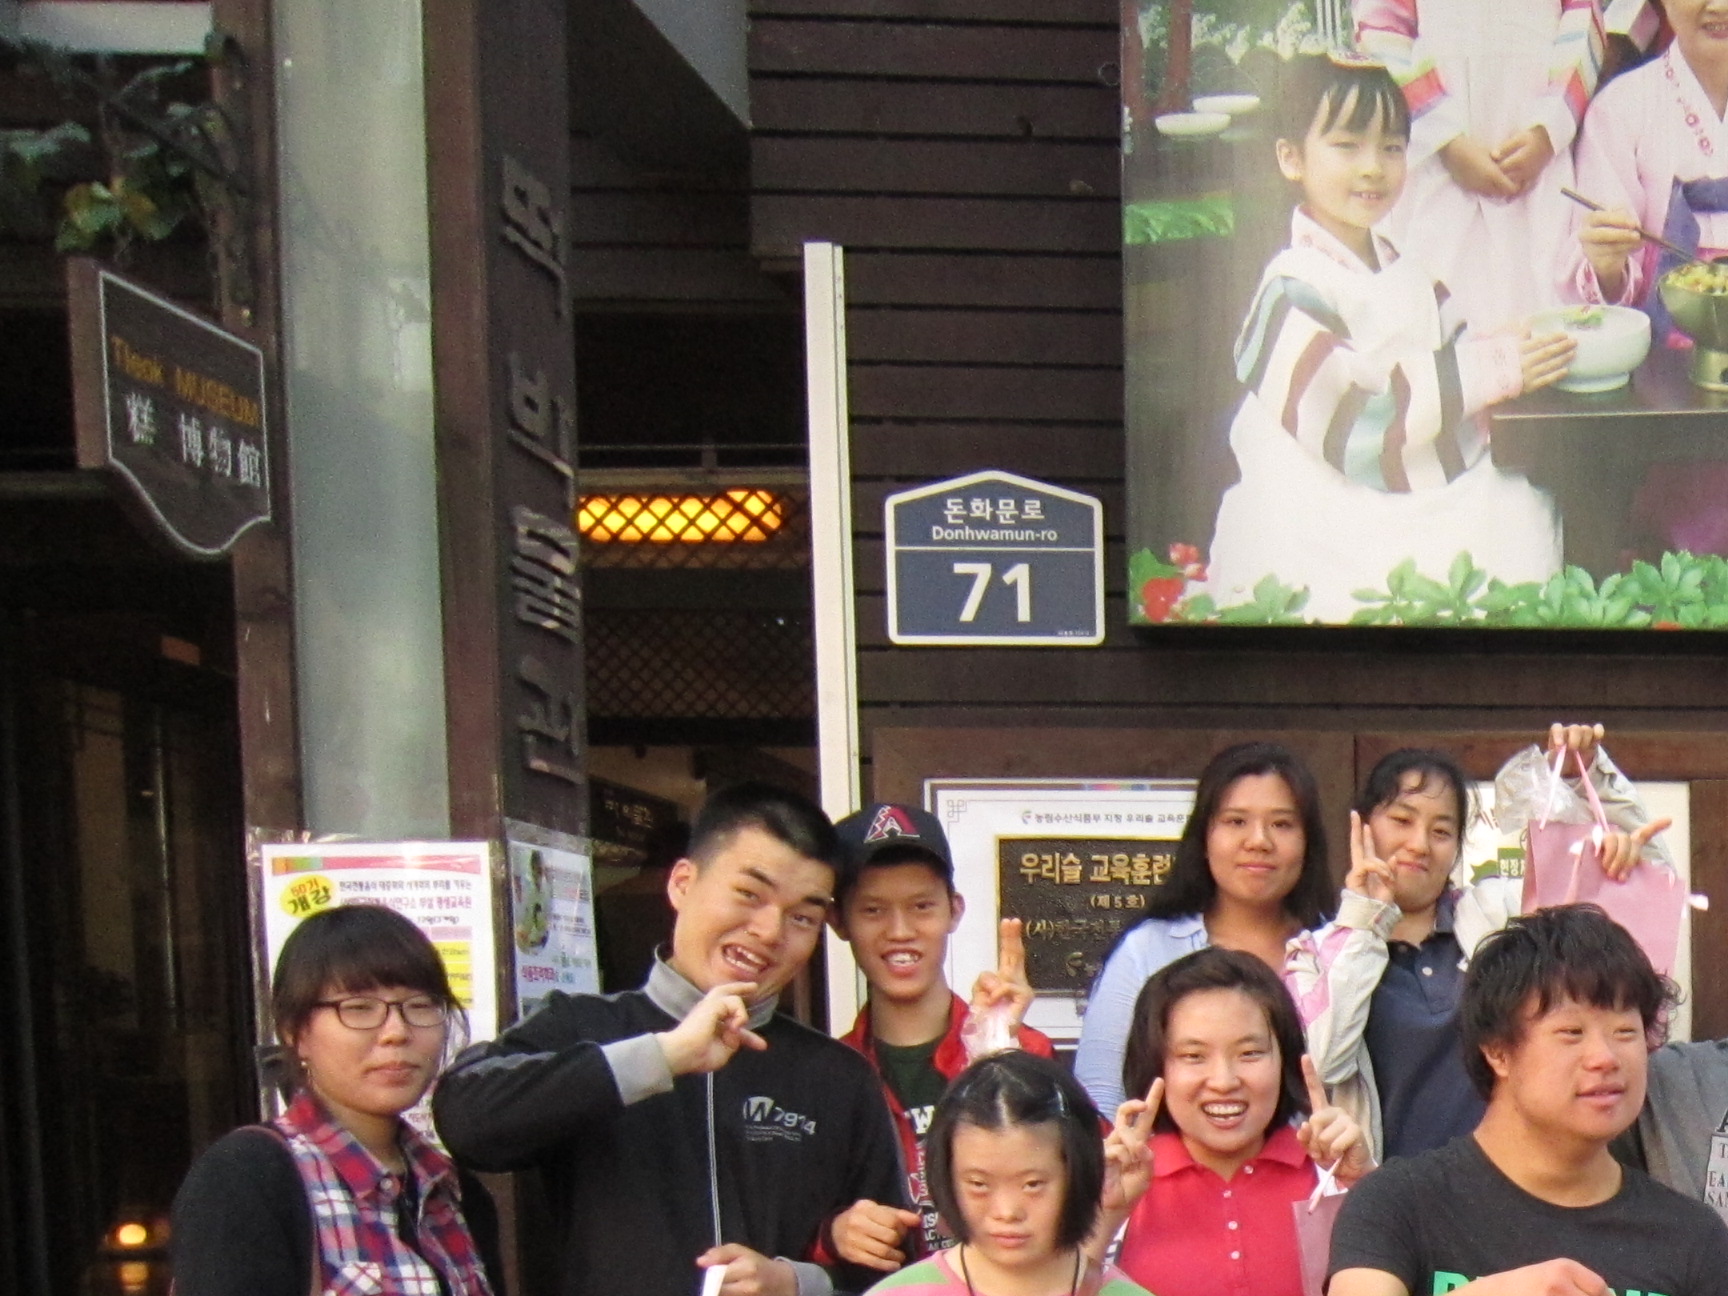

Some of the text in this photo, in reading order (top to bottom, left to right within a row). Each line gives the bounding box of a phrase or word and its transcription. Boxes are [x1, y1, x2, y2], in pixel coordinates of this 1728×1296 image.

[174, 365, 262, 429] MUSEUM
[943, 498, 1045, 524] 돈화문로
[931, 525, 1058, 542] Donhwamun-ro
[953, 562, 1031, 623] 71
[1020, 852, 1174, 885] 우리술 교육훈련
